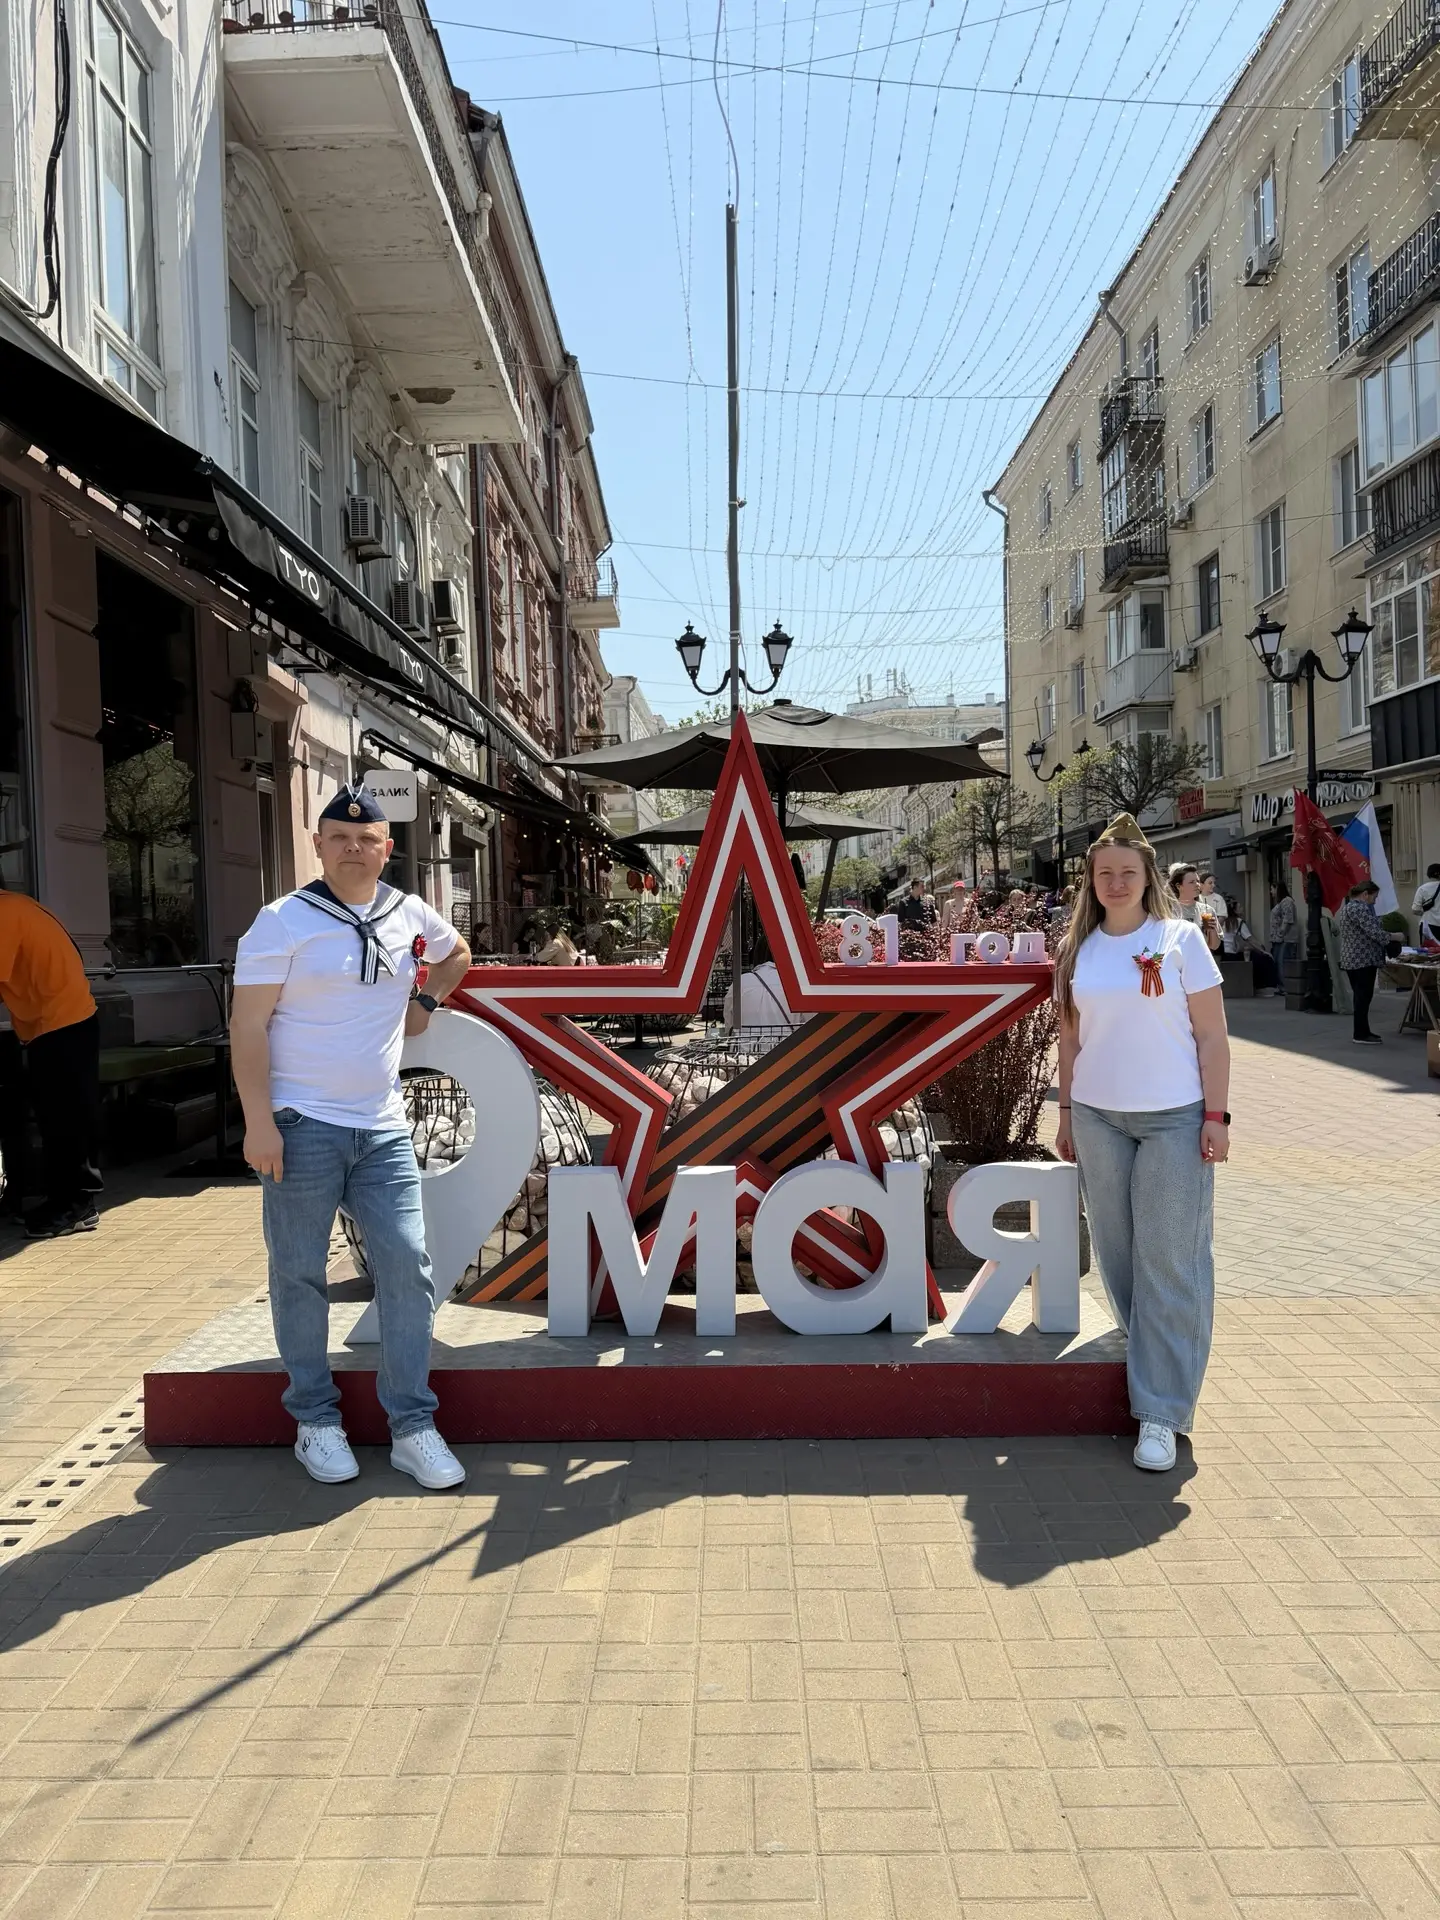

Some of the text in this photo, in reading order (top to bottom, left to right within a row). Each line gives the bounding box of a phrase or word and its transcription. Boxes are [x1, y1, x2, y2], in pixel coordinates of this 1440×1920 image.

[278, 545, 320, 601] TYO
[399, 647, 424, 683] TYO
[370, 787, 410, 798] БАЛИК
[1251, 793, 1280, 826] Мир
[837, 913, 899, 966] 81
[547, 1160, 1081, 1338] мая
